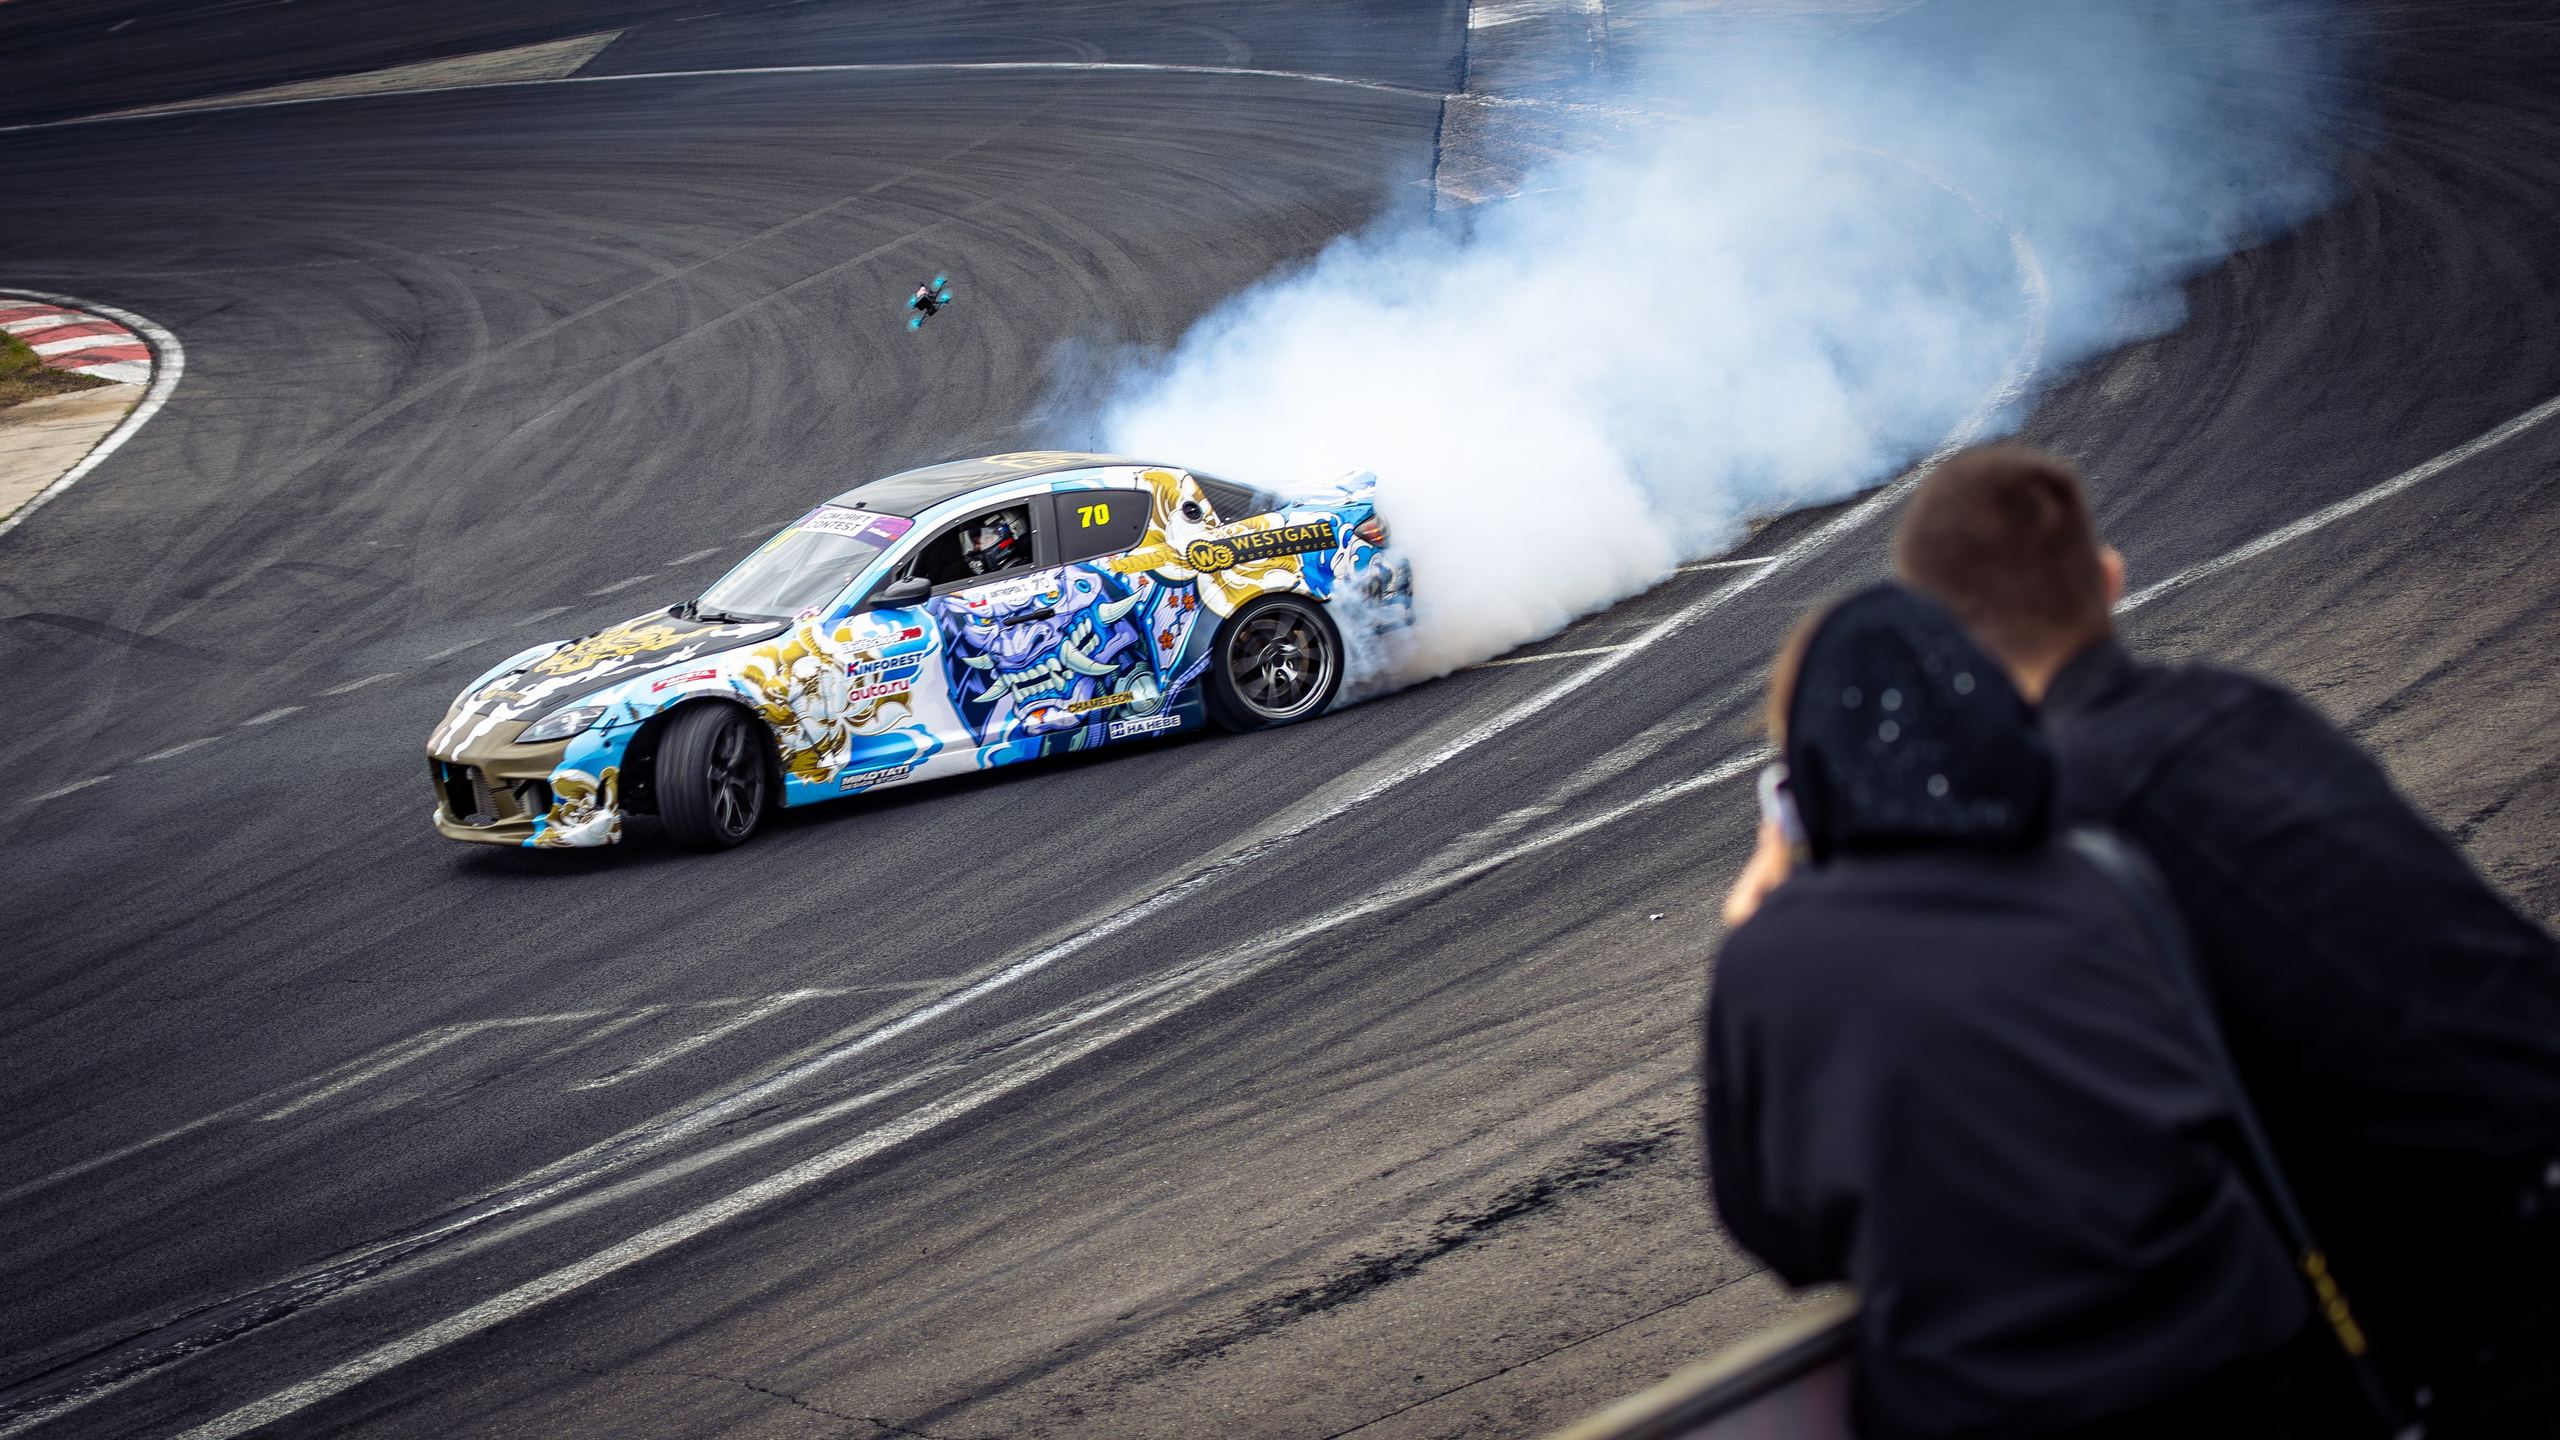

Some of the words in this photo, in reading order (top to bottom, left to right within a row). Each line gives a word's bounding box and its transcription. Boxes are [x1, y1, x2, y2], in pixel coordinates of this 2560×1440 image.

[806, 520, 862, 532] CONTEST
[840, 513, 872, 523] DRIFT
[1077, 503, 1110, 528] 70
[1231, 523, 1333, 550] WESTGATE
[1193, 546, 1230, 567] WG
[1238, 541, 1336, 561] AUTOSERVICE
[1031, 577, 1050, 591] 70
[847, 652, 923, 677] KINFOREST
[849, 679, 909, 702] auto.ru
[1067, 692, 1134, 712] CHAMELEON
[841, 764, 909, 785] MIKOTATI
